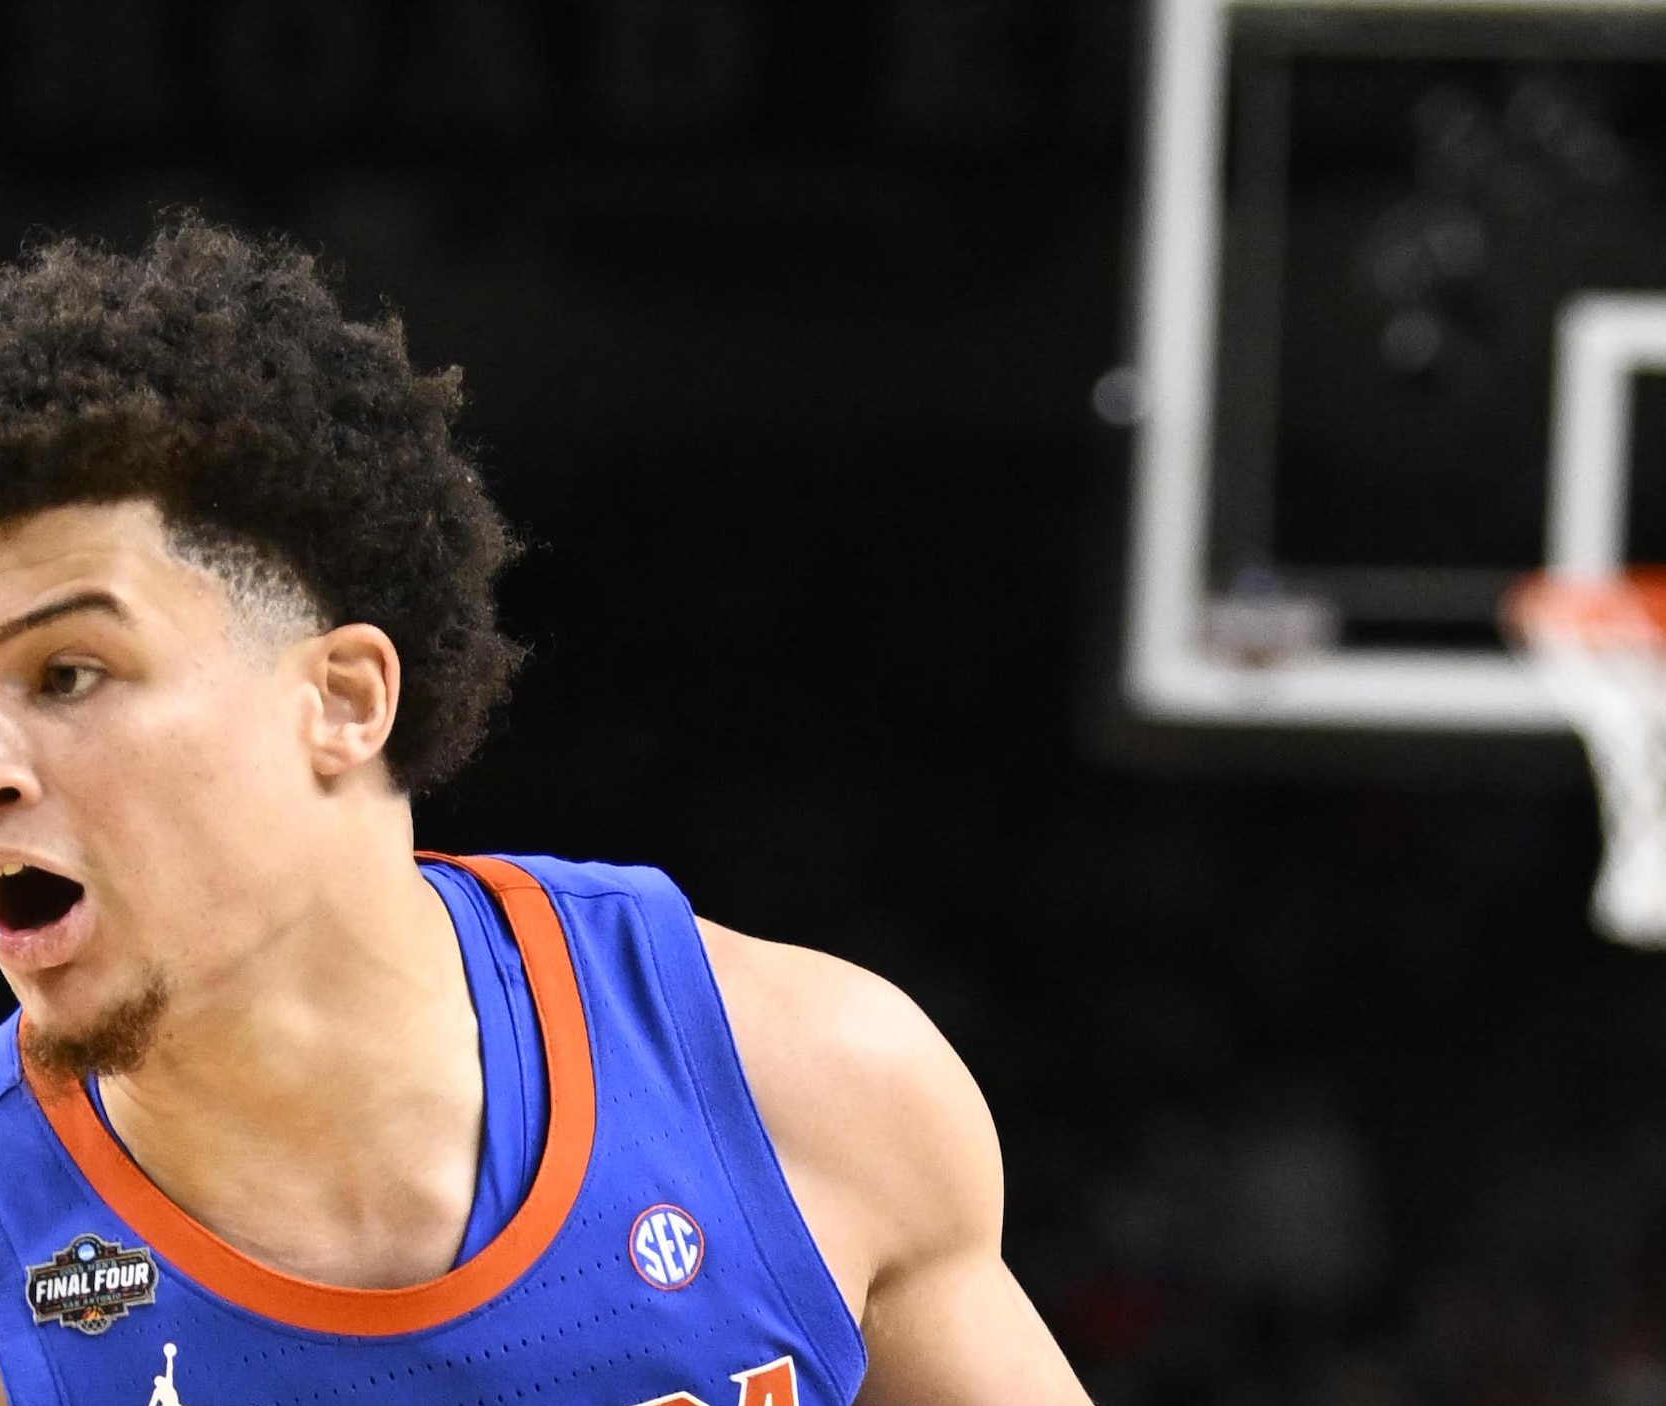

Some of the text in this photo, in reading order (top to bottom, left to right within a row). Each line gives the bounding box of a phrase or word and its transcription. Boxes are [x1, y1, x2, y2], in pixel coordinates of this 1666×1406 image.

[636, 1211, 698, 1284] SEC
[36, 1262, 149, 1303] FINAL FOUR
